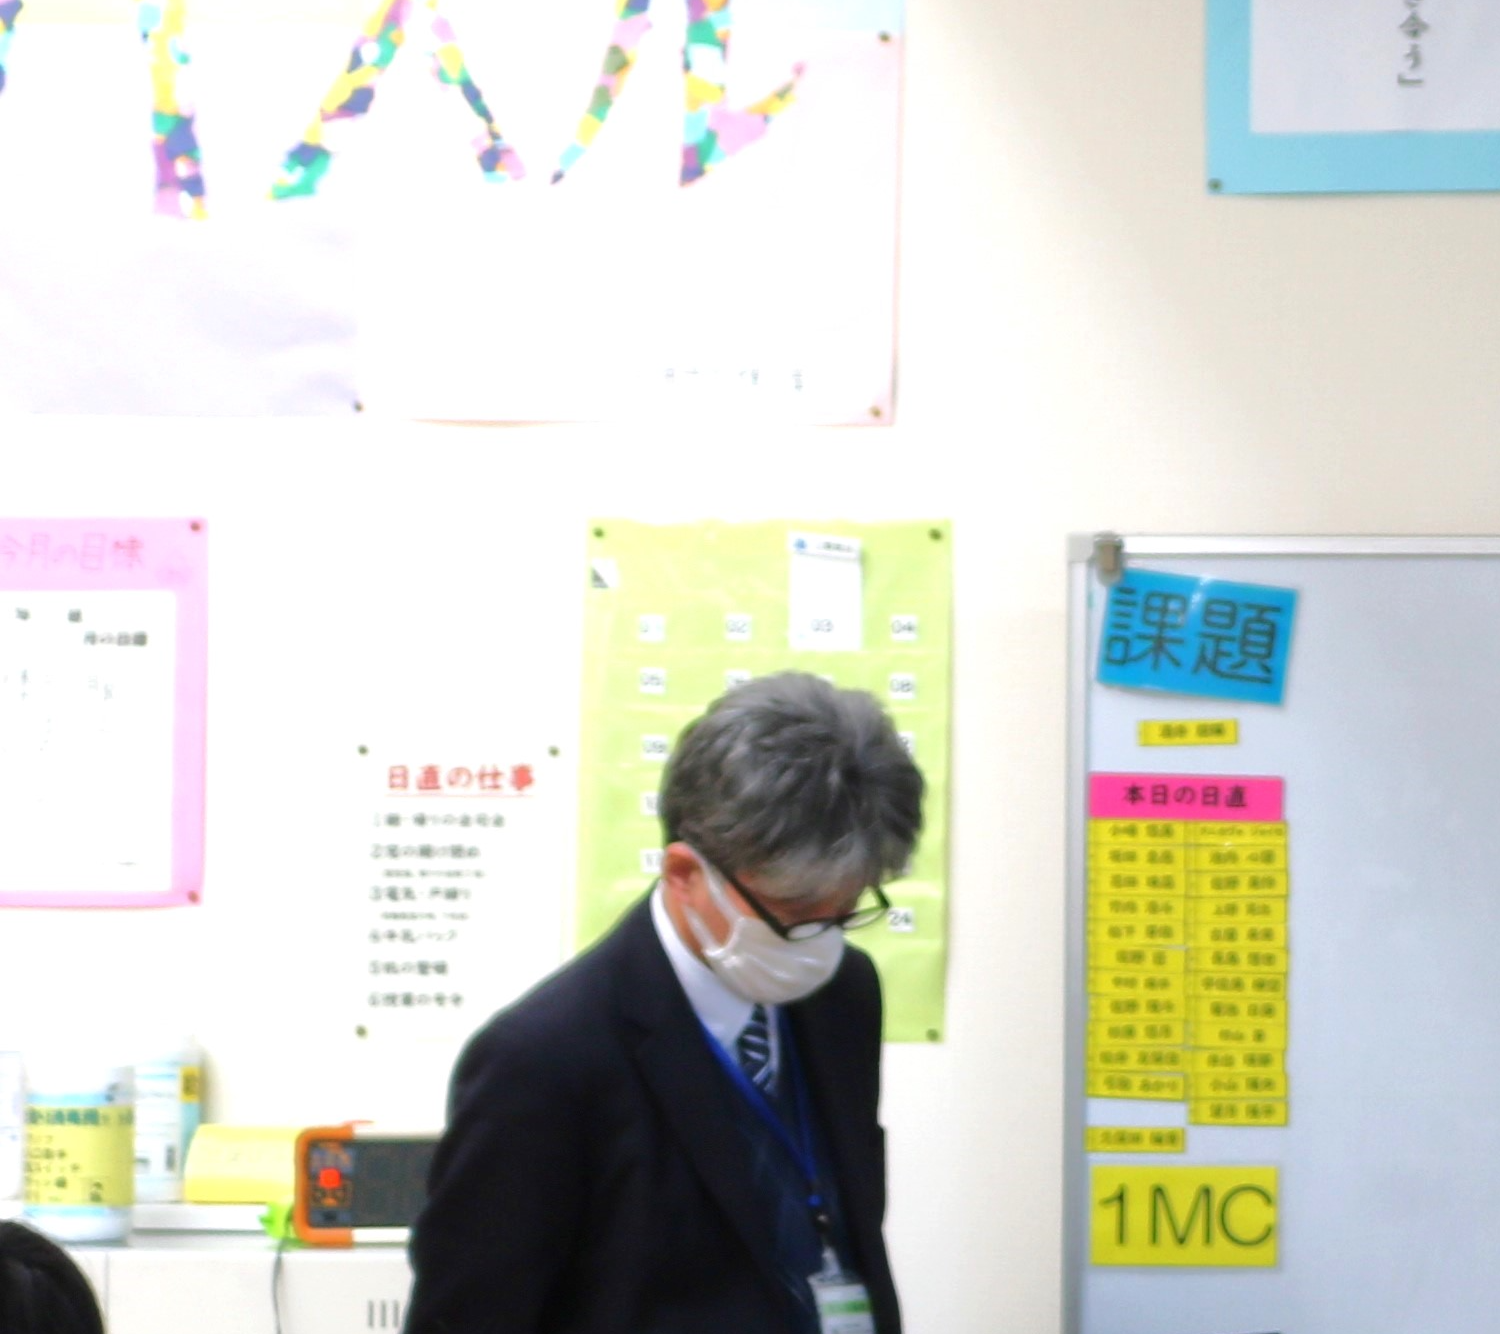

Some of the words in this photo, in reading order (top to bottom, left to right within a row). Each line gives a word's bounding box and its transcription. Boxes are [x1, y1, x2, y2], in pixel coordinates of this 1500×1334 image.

[1105, 587, 1281, 684] 課題
[388, 764, 535, 791] 日直の仕事
[1124, 784, 1248, 808] 本日の日直
